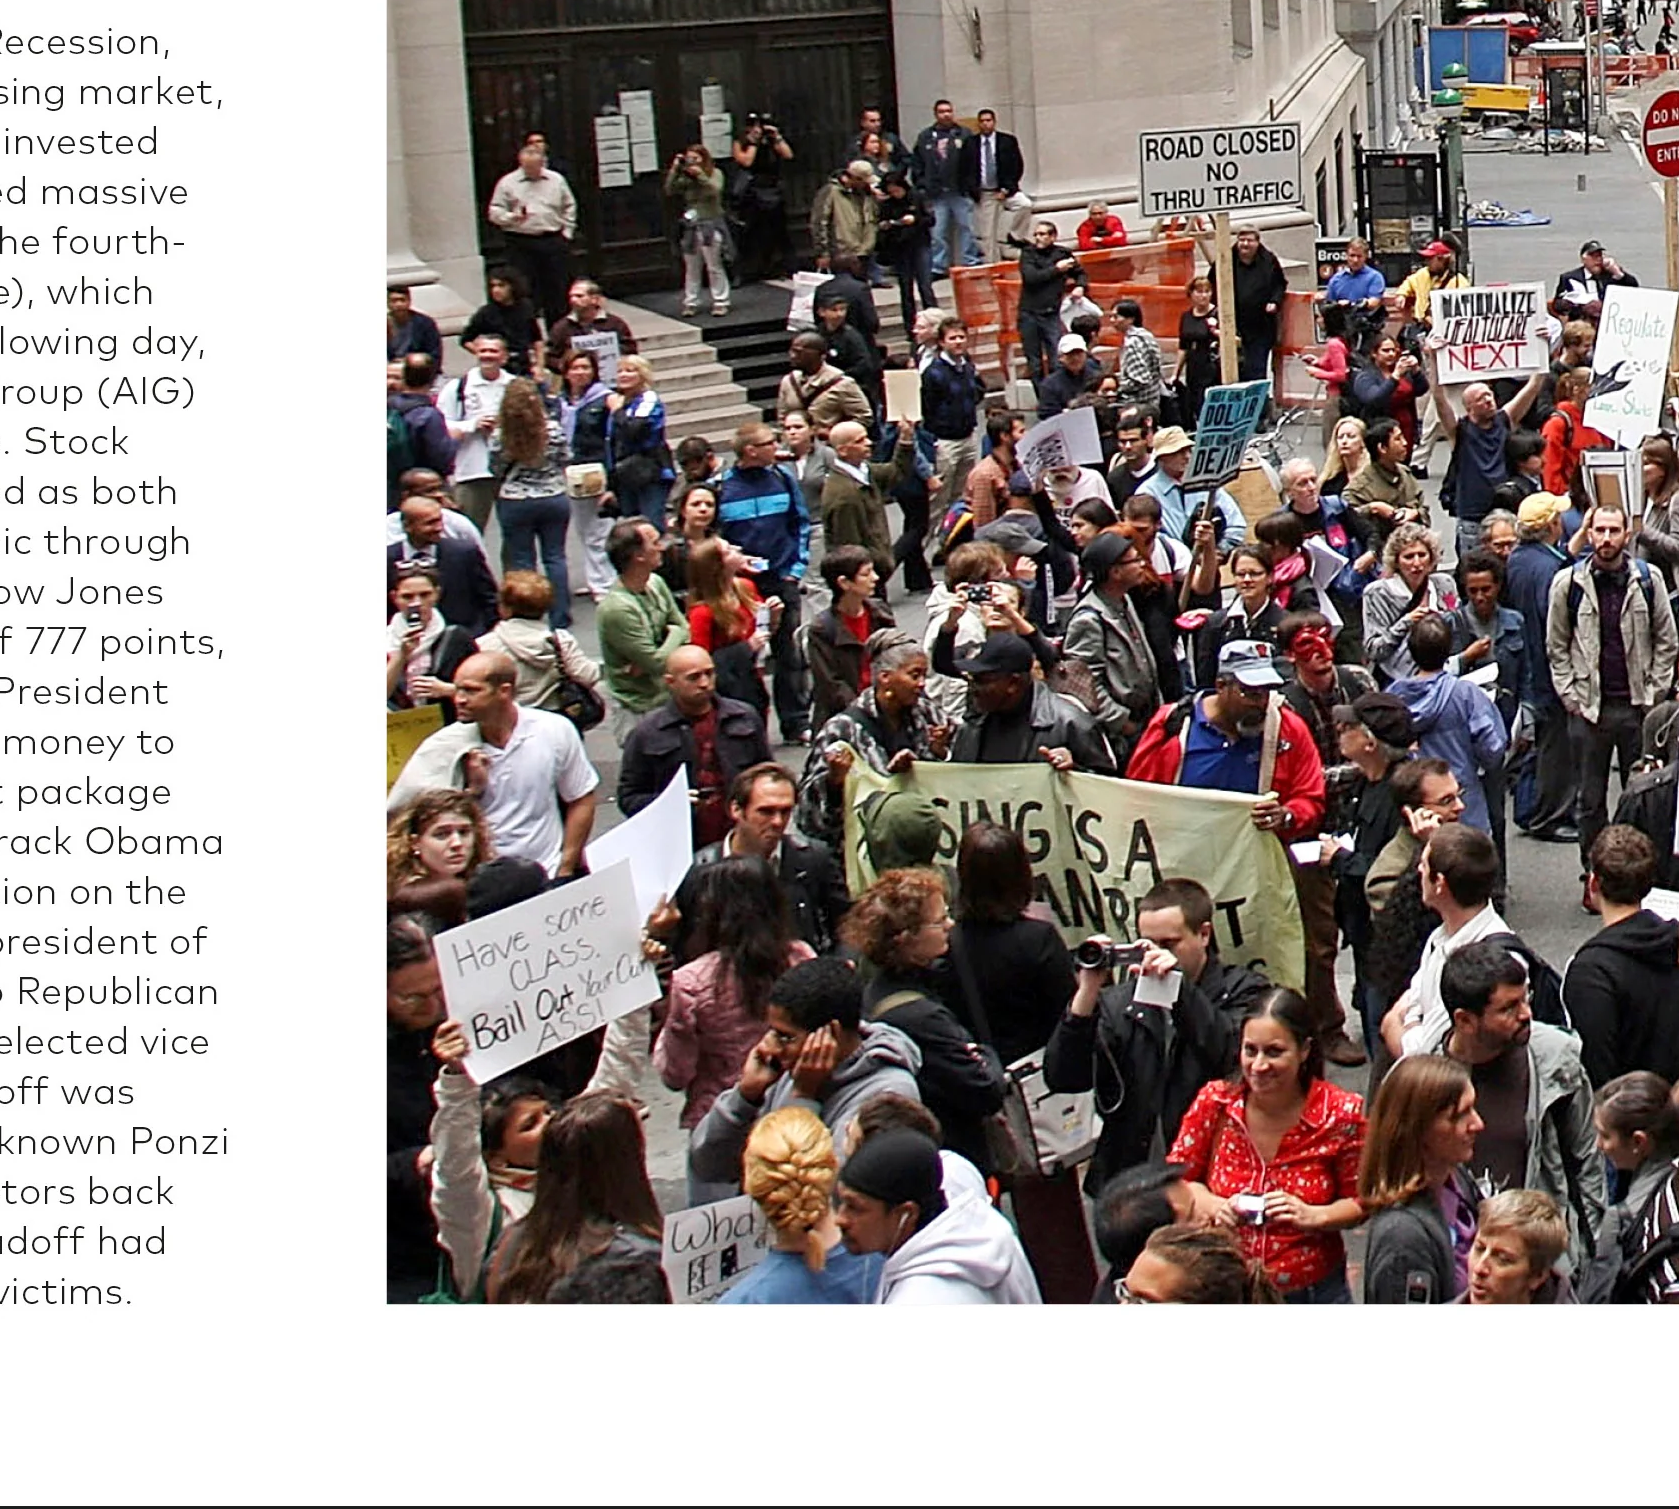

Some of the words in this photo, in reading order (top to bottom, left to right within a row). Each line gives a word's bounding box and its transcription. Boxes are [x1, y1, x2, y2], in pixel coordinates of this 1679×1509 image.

[1652, 108, 1669, 125] DO
[1145, 135, 1204, 162] ROAD
[1213, 128, 1296, 157] CLOSED
[1206, 161, 1239, 182] NO
[1150, 187, 1205, 212] THRU
[1213, 180, 1294, 206] TRAFFIC
[1318, 249, 1347, 261] Broa
[1448, 342, 1528, 371] NEXT
[1064, 803, 1109, 874] IS
[1124, 818, 1165, 886] A
[452, 931, 530, 977] Have
[471, 1000, 526, 1050] Bail
